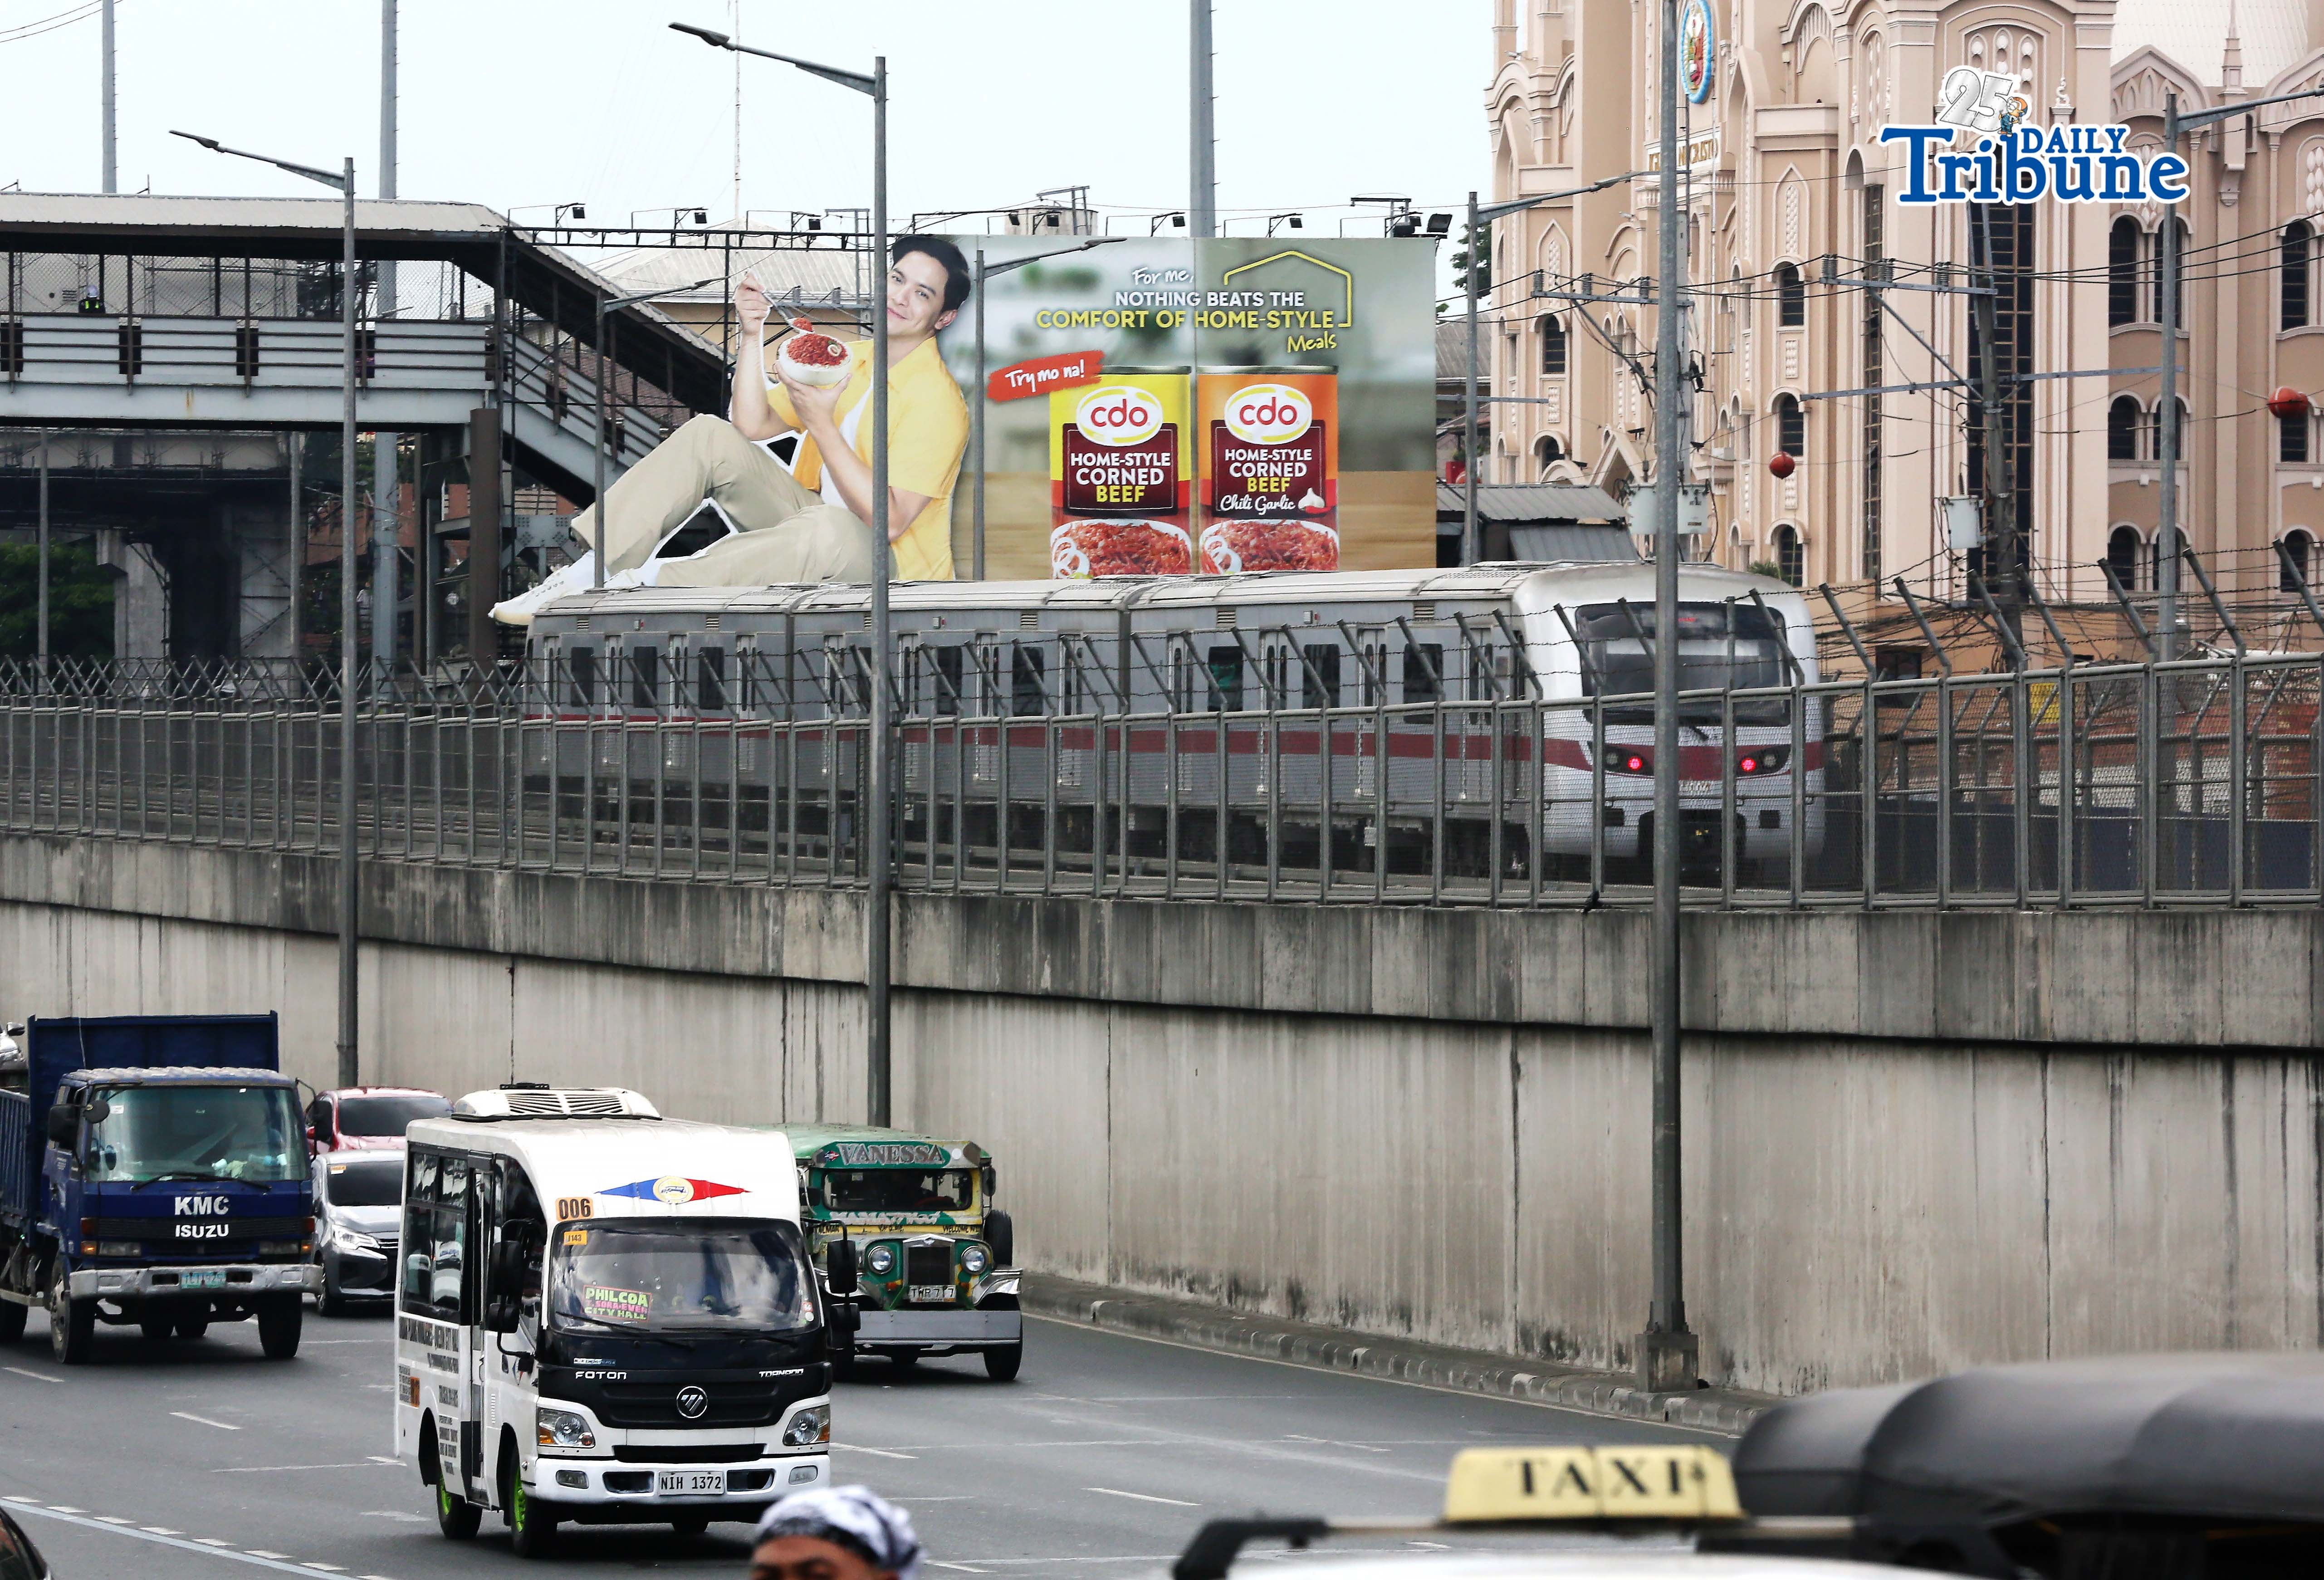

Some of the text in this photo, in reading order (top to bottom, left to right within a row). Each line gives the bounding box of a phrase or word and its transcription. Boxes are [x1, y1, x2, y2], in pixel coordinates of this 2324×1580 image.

[1132, 267, 1194, 285] For me,
[1115, 291, 1304, 307] NOTHING BEATS THE
[1036, 310, 1334, 329] COMFORT OF HOME-STYLE
[1287, 330, 1337, 353] Meals
[1004, 359, 1085, 392] Try mo na!
[1091, 399, 1148, 427] cdo
[1239, 397, 1297, 425] cdo
[1071, 452, 1171, 466] HOME-STYLE
[1225, 449, 1312, 461] HOME-STYLE
[1076, 468, 1164, 485] CORNED
[1229, 462, 1307, 478] CORNED
[1247, 477, 1291, 492] BEEF
[1096, 485, 1146, 503] BEEF
[1220, 494, 1296, 515] Chili Garlic
[836, 1143, 946, 1166] VANESSA
[174, 1196, 229, 1216] KMC
[559, 1198, 591, 1220] 006
[175, 1224, 229, 1238] ISUZU
[585, 1287, 648, 1307] PHILCOA
[584, 1306, 647, 1320] CITY HALL
[575, 1371, 627, 1380] FOTON
[661, 1476, 722, 1490] NIH 1372
[1505, 1457, 1686, 1497] TAXI
